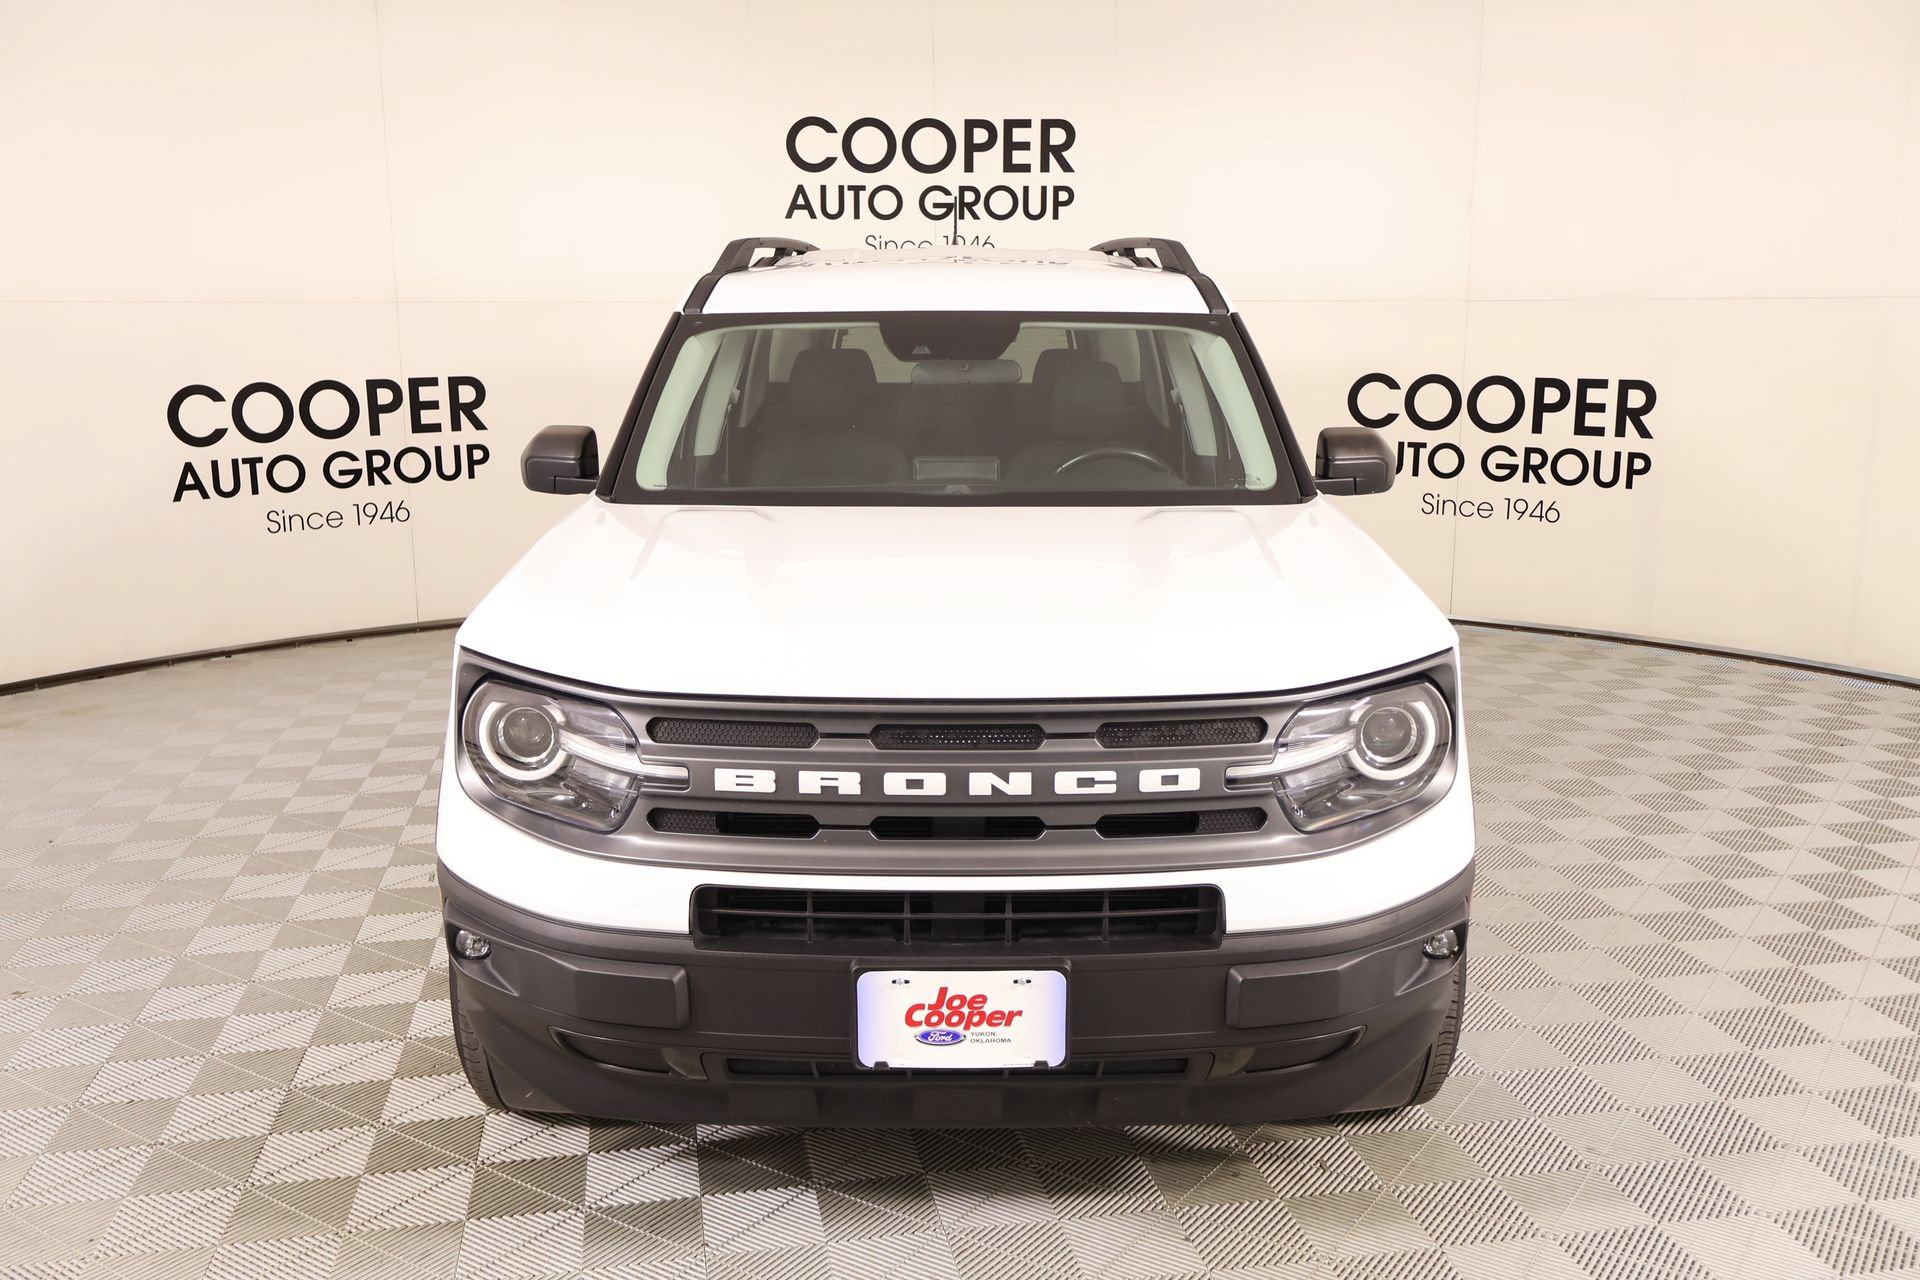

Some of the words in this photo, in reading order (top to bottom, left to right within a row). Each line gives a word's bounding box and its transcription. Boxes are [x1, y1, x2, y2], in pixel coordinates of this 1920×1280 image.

[785, 116, 1076, 174] COOPER
[785, 184, 903, 221] AUTO
[918, 184, 1075, 221] GROUP
[166, 376, 489, 448] COOPER
[1347, 372, 1657, 440] COOPER
[172, 454, 306, 503] AUTO
[322, 443, 490, 490] GROUP
[1395, 441, 1465, 480] TO
[1480, 445, 1652, 490] GROUP
[266, 508, 344, 534] Since
[352, 499, 411, 526] 1946
[1421, 492, 1494, 519] Since
[1503, 497, 1561, 524] 1946
[714, 768, 1201, 796] BRONCO
[904, 1003, 1023, 1030] Cooper
[927, 986, 988, 1011] Joe
[927, 1030, 953, 1042] Ford
